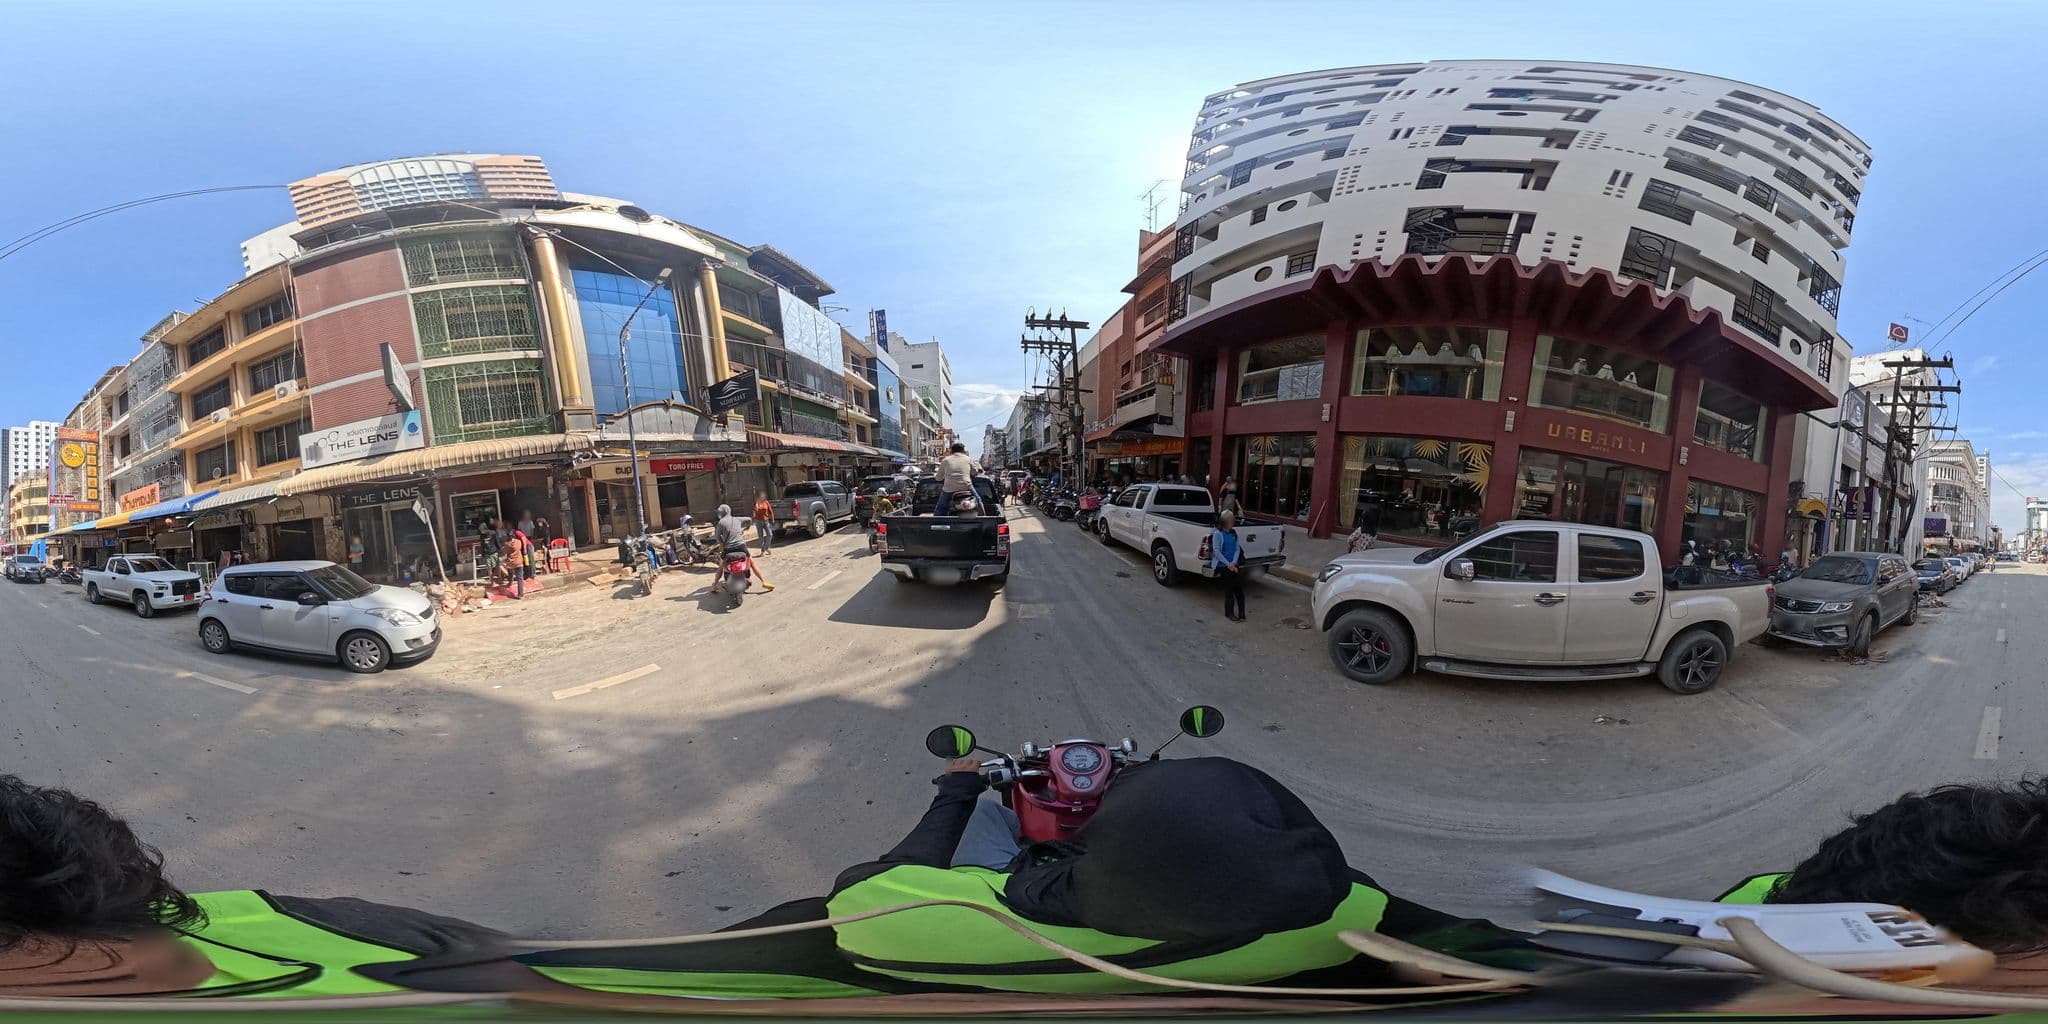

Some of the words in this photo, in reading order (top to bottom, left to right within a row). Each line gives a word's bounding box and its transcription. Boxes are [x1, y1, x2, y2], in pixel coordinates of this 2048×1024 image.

[328, 439, 356, 452] THE
[359, 430, 399, 446] LENS
[667, 463, 686, 471] TORO
[687, 462, 704, 470] FRIES
[352, 493, 377, 505] THE
[383, 486, 420, 501] LENS
